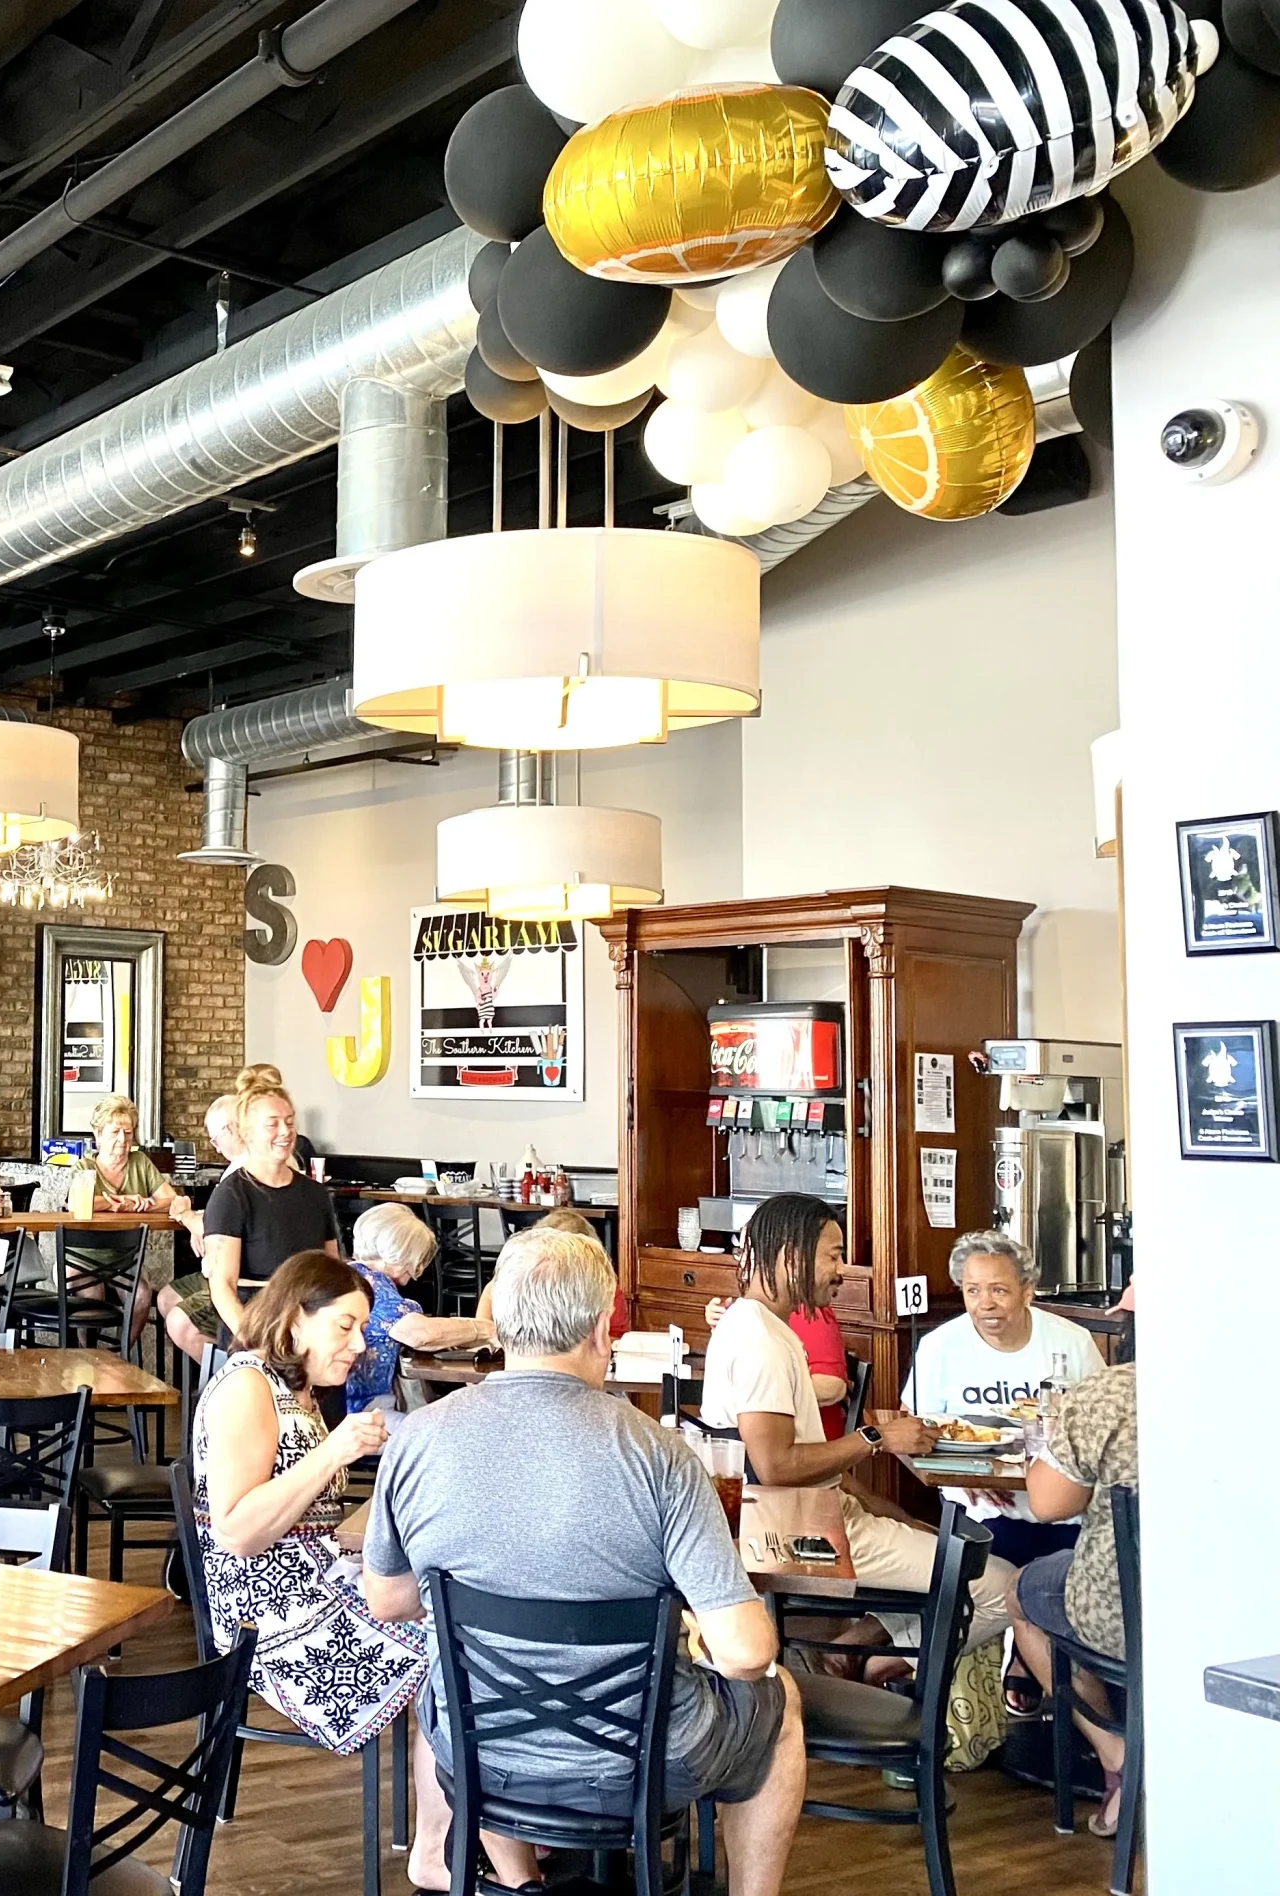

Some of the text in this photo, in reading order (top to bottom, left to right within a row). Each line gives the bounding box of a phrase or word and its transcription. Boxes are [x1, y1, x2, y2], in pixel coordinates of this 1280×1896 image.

[243, 864, 298, 966] S
[422, 921, 560, 953] SUGARJAM
[327, 976, 391, 1088] J
[422, 1037, 536, 1055] The Southern Kitchen
[901, 1283, 922, 1308] 18
[963, 1381, 1039, 1404] adid
